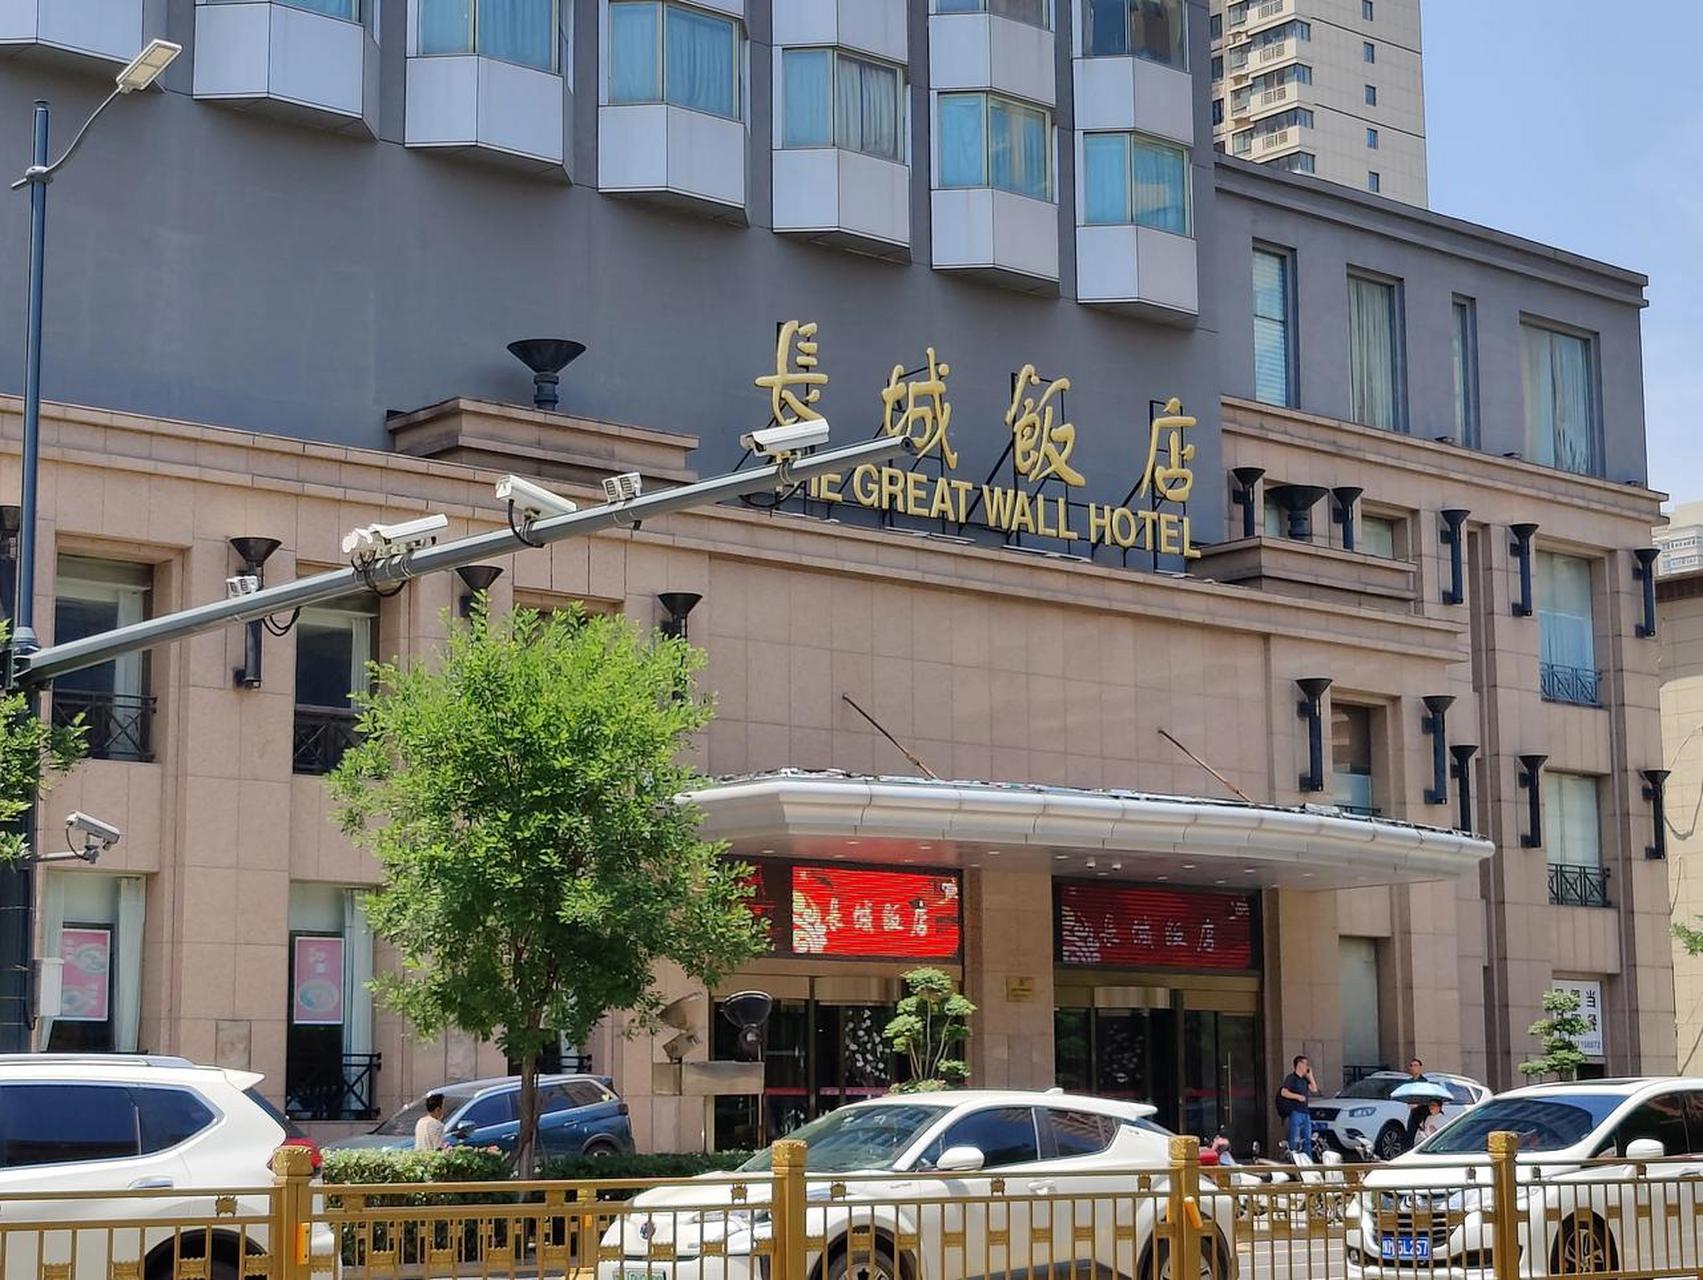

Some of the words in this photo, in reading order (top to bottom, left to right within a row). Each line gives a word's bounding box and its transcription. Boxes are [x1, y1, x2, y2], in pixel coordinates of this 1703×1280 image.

[853, 463, 972, 524] GREAT
[982, 484, 1079, 541] WALL
[1088, 502, 1202, 558] HOTEL
